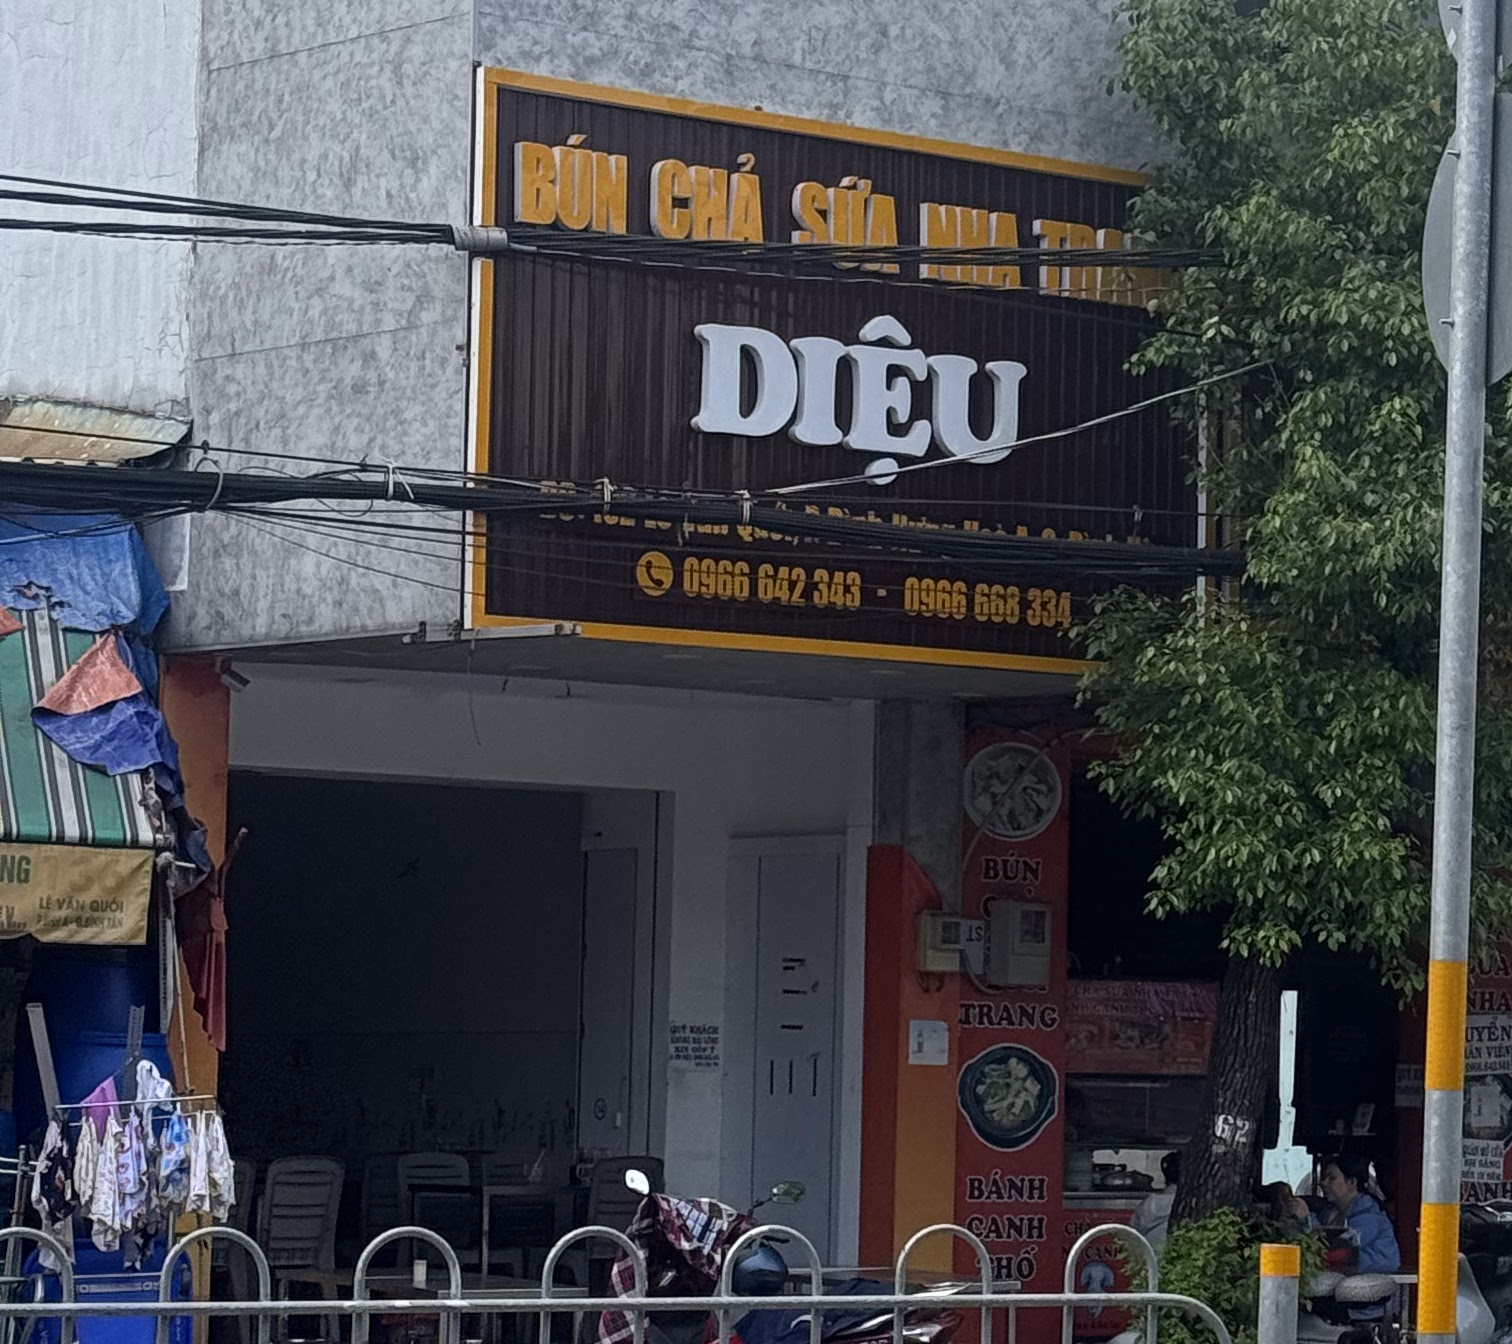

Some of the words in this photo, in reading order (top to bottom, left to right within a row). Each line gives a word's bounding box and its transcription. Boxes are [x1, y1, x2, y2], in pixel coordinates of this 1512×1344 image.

[514, 134, 628, 235] BÚN
[650, 152, 764, 248] CHẢ
[919, 203, 1023, 289] NHA
[690, 315, 1028, 485] DIỆU
[683, 556, 750, 601] 0966
[757, 563, 806, 607] 642
[812, 568, 862, 612] 343
[904, 576, 968, 620] 0966
[974, 583, 1021, 624] 668
[1026, 588, 1072, 628] 334
[982, 852, 1042, 883] BÚN
[959, 1001, 1059, 1031] TRANG
[1466, 1016, 1512, 1043] UYỂN
[967, 1169, 1048, 1202] BÁNH
[966, 1215, 1046, 1241] CANH
